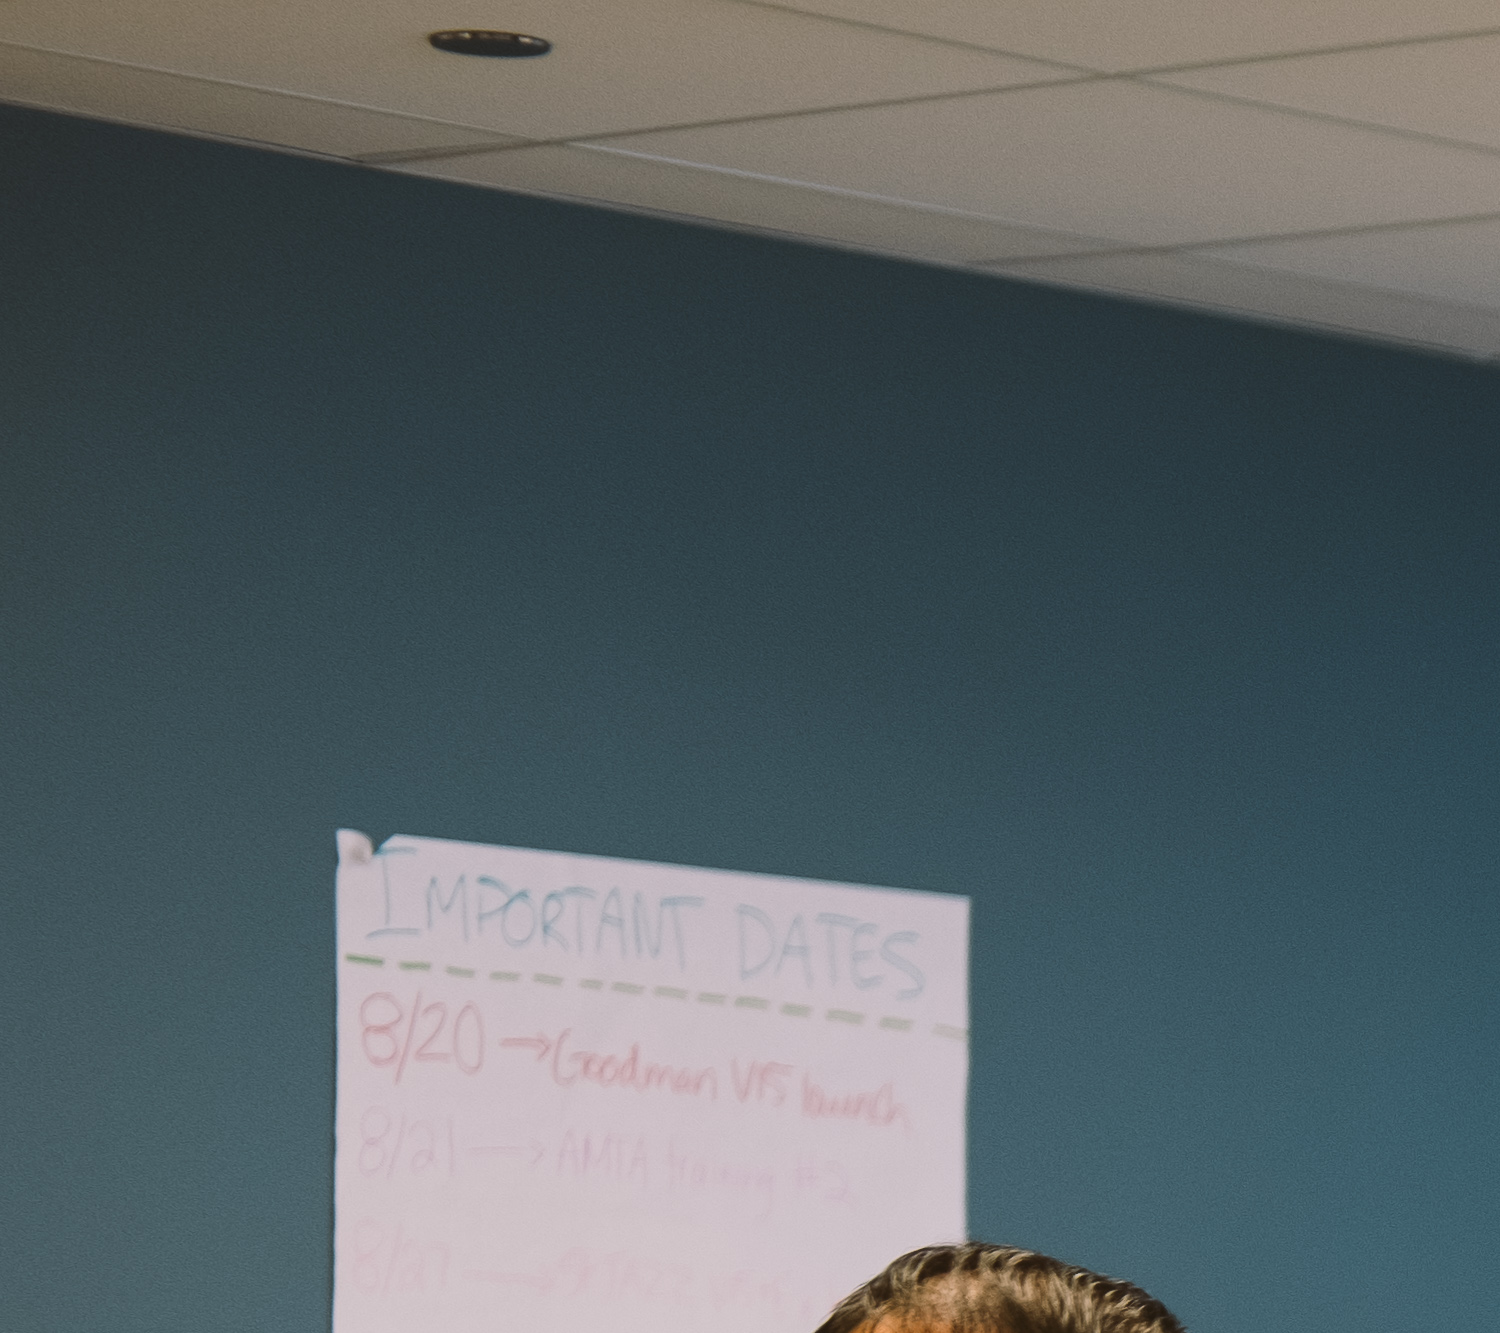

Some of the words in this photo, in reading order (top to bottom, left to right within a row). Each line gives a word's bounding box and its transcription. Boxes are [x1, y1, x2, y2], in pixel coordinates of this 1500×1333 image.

[365, 845, 705, 970] IMPORTANT
[737, 902, 927, 1002] DATES
[358, 990, 486, 1086] 8/20
[357, 1105, 459, 1182] 8/21
